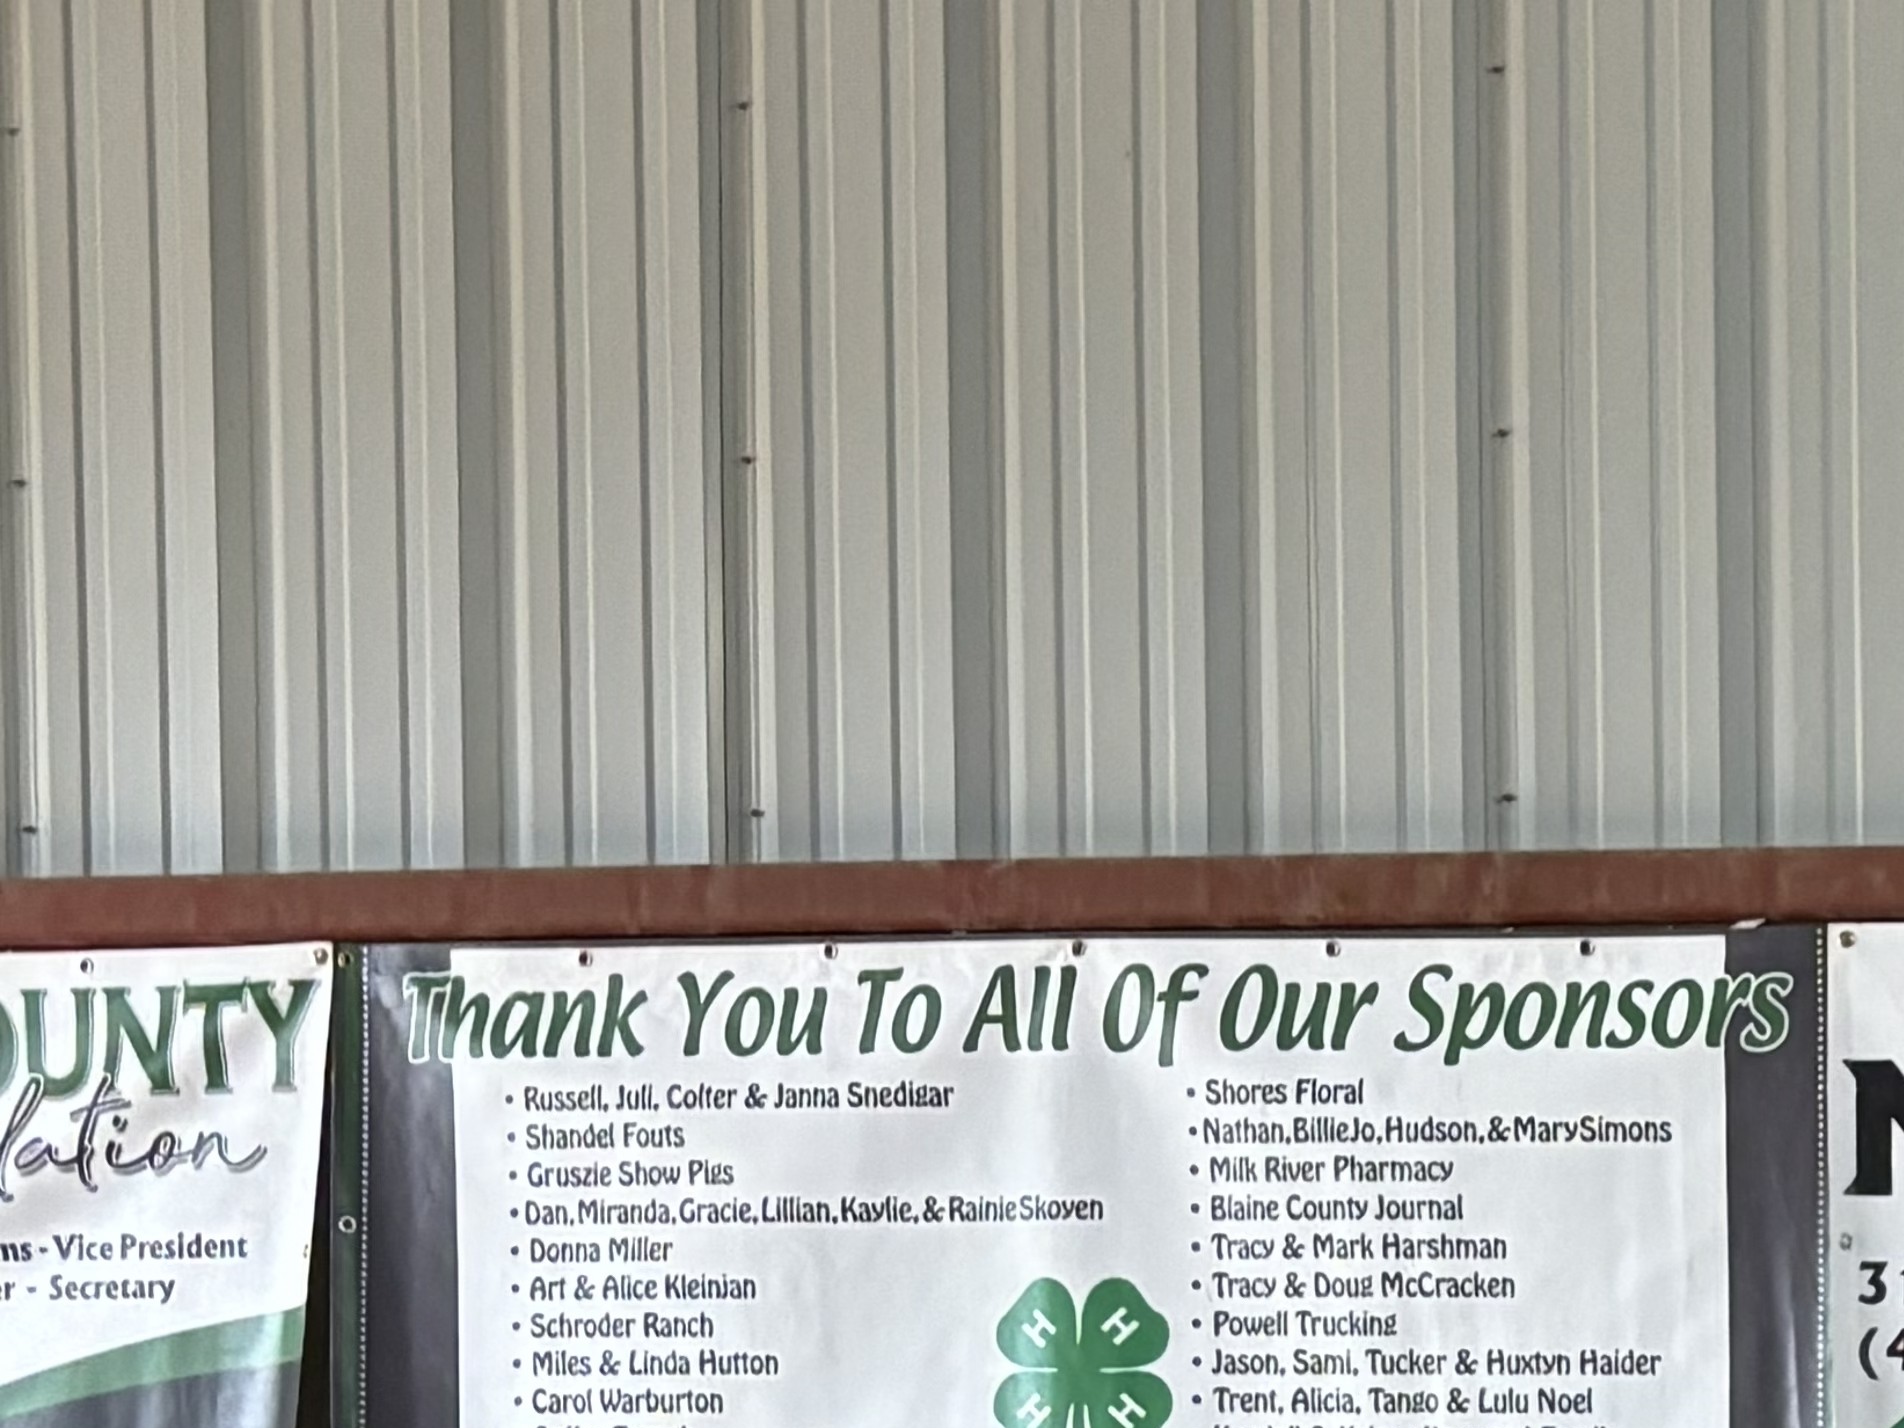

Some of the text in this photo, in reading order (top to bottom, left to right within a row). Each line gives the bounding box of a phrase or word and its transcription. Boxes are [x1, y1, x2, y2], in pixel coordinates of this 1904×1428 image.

[402, 962, 1794, 1067] Thank You To All Of Our Sponsors
[524, 1084, 609, 1113] Russell,
[667, 1083, 737, 1109] Colter
[744, 1083, 767, 1109] &
[774, 1083, 839, 1109] Janna
[847, 1080, 954, 1108] Snedigar
[1206, 1078, 1363, 1105] Shores Floral
[526, 1122, 685, 1150] Shandel Fouts
[619, 1161, 680, 1187] Show
[688, 1159, 734, 1185] Pigs
[1210, 1155, 1454, 1183] Milk River Pharmacy
[1211, 1194, 1463, 1221] Blaine County Journal
[52, 1234, 113, 1261] Vice
[121, 1232, 247, 1260] President
[530, 1236, 673, 1263] Donna Miller
[1211, 1233, 1506, 1260] Tracy & Mark Harshman
[49, 1274, 175, 1304] Secretary
[530, 1274, 756, 1301] Art & Alice Kleinjan
[1212, 1271, 1515, 1299] Tracy & Doug McCracken
[531, 1312, 713, 1338] Schroder Ranch
[1214, 1310, 1397, 1337] Powell Trucking
[533, 1349, 778, 1376] Miles & Linda Hutton
[1211, 1349, 1286, 1376] Jason,
[1365, 1348, 1447, 1375] Tucker
[1455, 1349, 1478, 1375] &
[1580, 1349, 1662, 1376] Haider
[532, 1388, 723, 1414] Carol Warburton
[1213, 1386, 1592, 1415] Trent, Alicia, Tango & Lulu Noel
